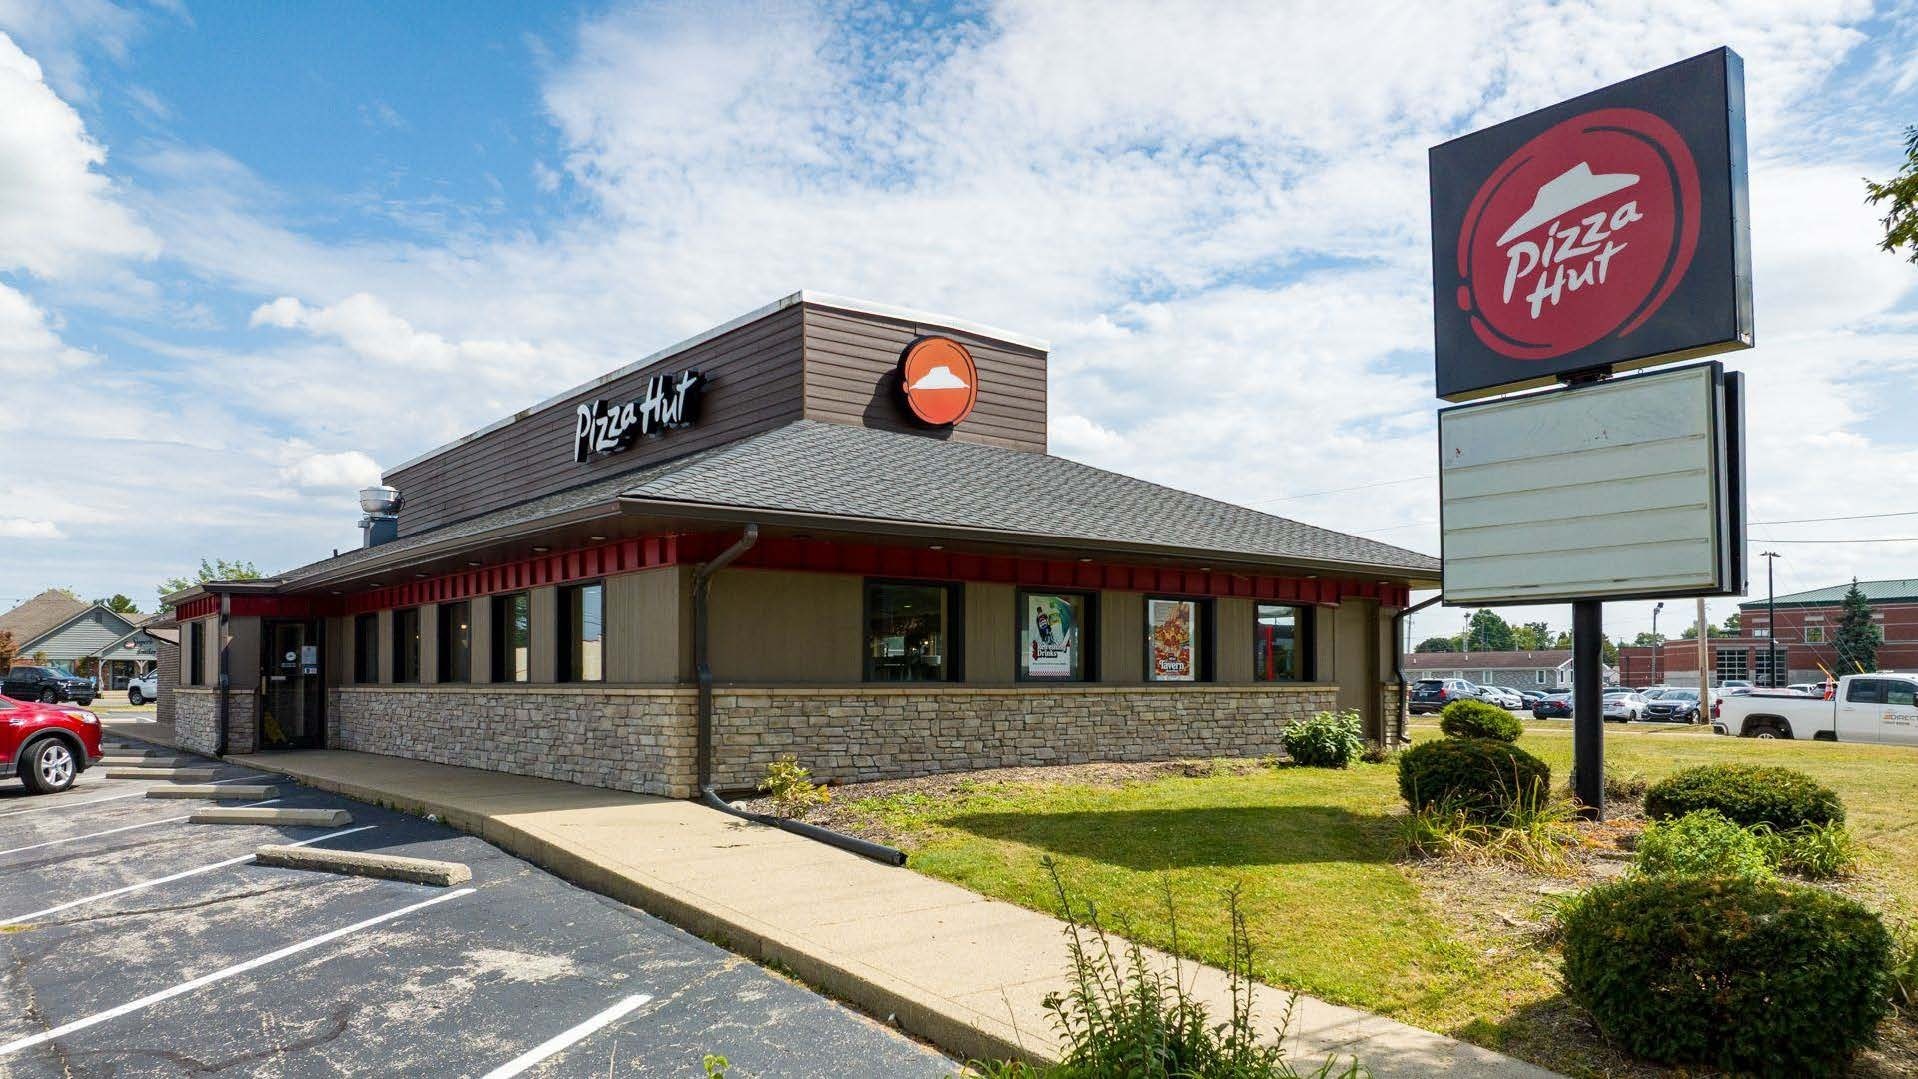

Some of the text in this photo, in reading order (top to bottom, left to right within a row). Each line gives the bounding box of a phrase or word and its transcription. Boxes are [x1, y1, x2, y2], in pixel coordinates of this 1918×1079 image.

[1503, 200, 1643, 304] Pizza
[1526, 240, 1628, 320] Hut
[574, 370, 698, 463] Pizza Hut
[1037, 650, 1058, 658] Drinks
[1159, 659, 1185, 671] Tavern
